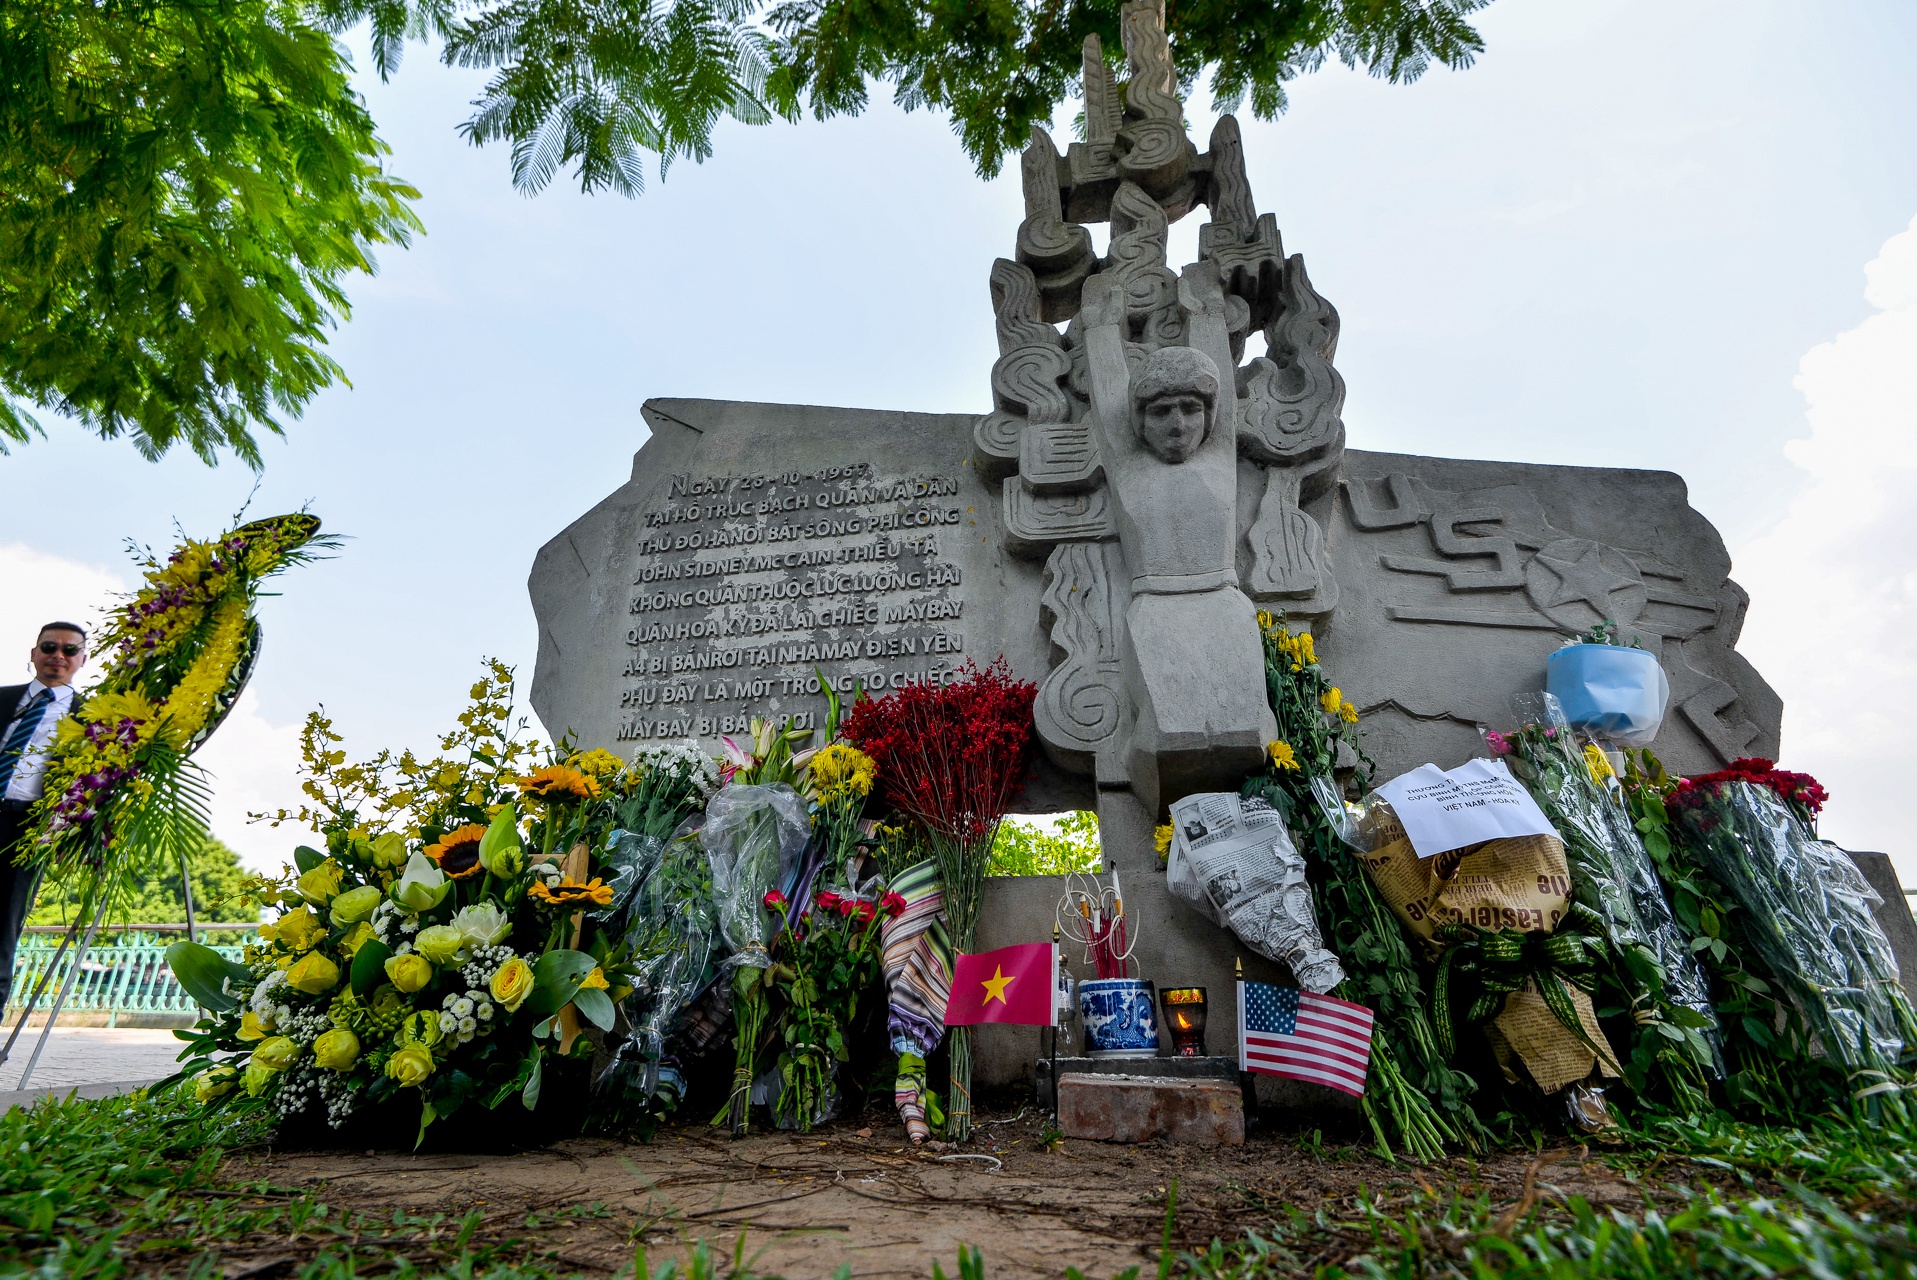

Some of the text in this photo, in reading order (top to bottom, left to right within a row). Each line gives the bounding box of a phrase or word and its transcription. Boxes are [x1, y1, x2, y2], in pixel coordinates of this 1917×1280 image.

[867, 514, 899, 532] PHI
[633, 562, 681, 585] JOHN
[684, 556, 753, 578] SIDNEY
[622, 658, 647, 676] A4
[780, 676, 852, 696] TRONG
[1464, 798, 1487, 808] NAM
